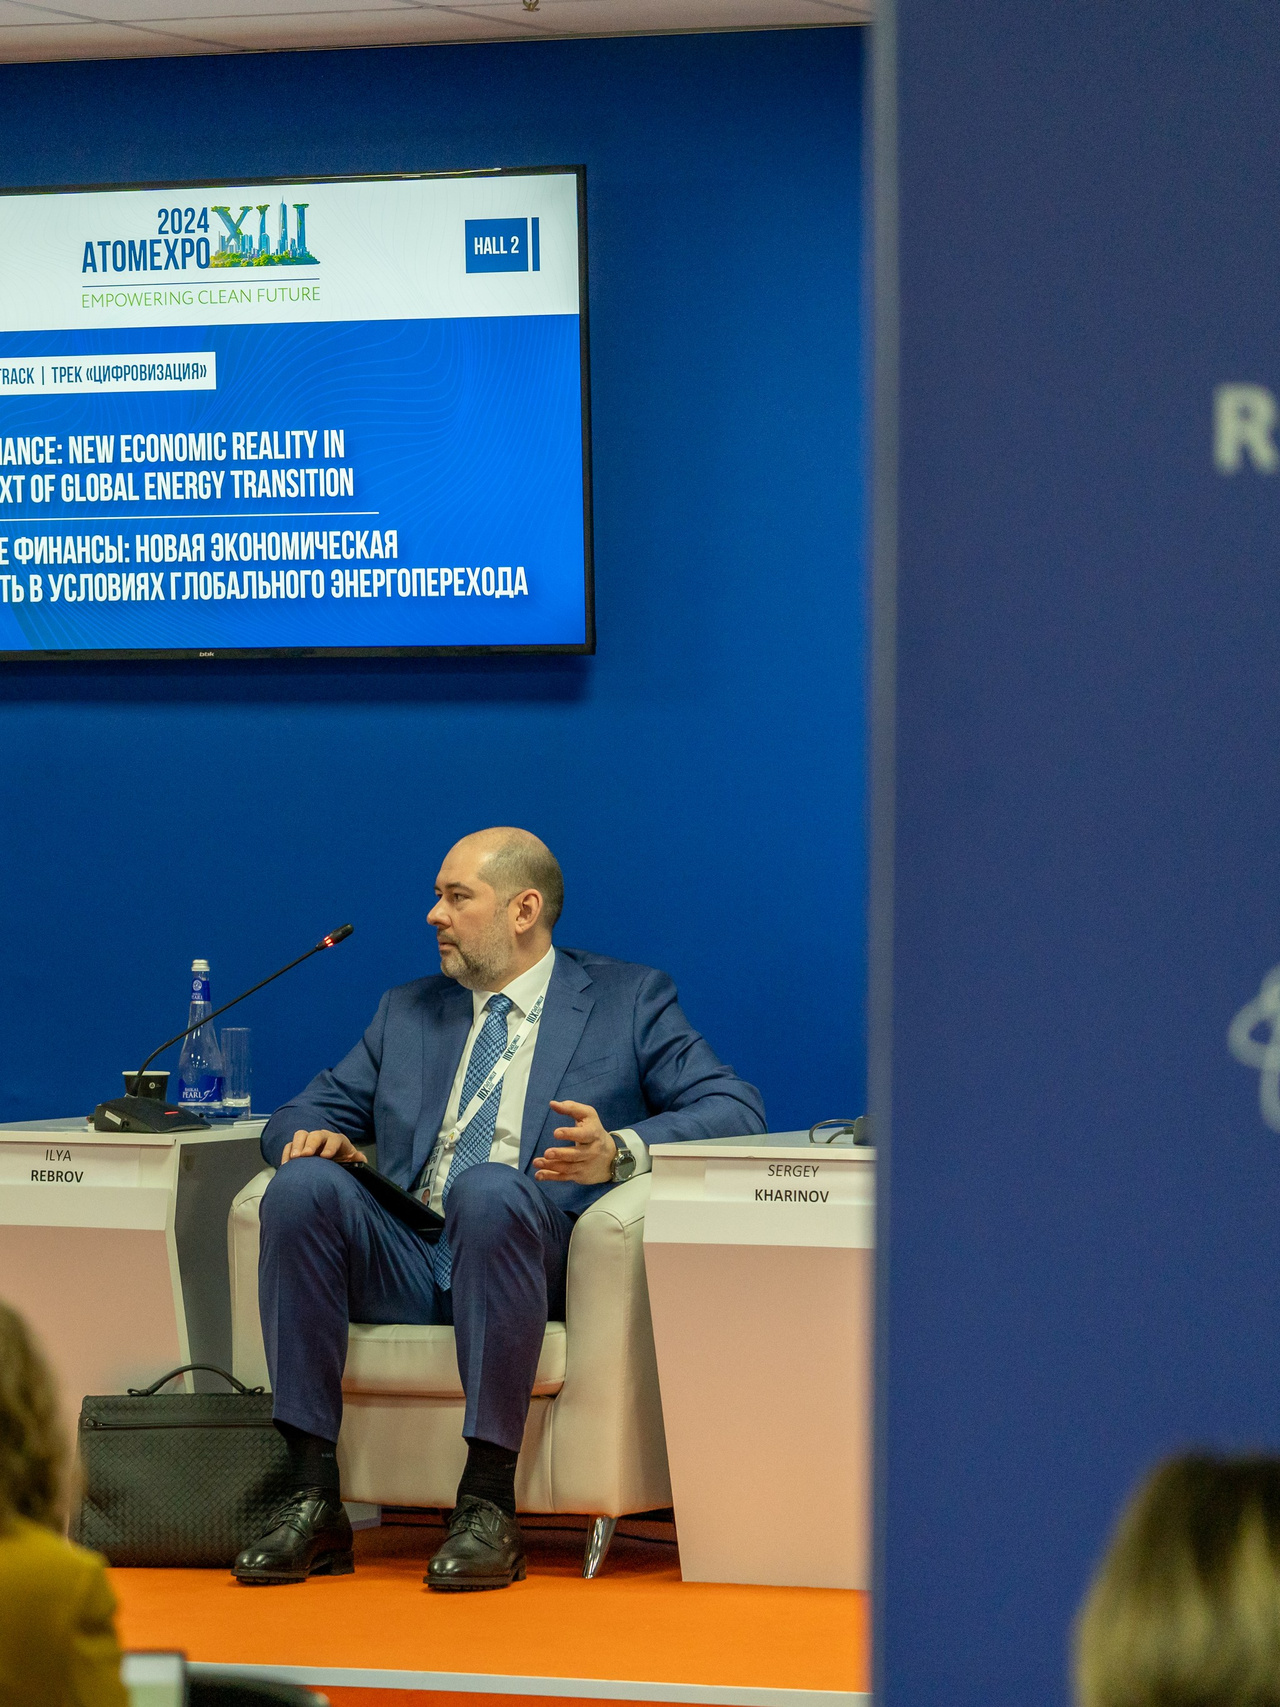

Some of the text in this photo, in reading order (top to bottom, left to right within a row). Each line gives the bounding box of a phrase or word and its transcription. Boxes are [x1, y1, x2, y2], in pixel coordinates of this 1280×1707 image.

[157, 207, 210, 235] 2024
[82, 237, 210, 273] ATOMEXPO
[474, 235, 520, 255] HALL 2
[82, 286, 321, 309] EMPOWERING CLEAN FUTURE
[51, 366, 83, 384] ТРЕК
[86, 362, 207, 384] «ЦИФРОВИЗАЦИЯ»
[69, 434, 115, 464] NEW
[120, 431, 227, 463] ECONOMIC
[232, 429, 318, 460] REALITY
[323, 429, 345, 459] IN
[30, 474, 56, 503] OF
[61, 471, 140, 503] GLOBAL
[144, 469, 225, 500] ENERGY
[230, 467, 354, 499] TRANSITION
[13, 534, 130, 565] ФИНАНСЫ:
[135, 533, 205, 563] НОВАЯ
[210, 529, 398, 562] ЭКОНОМИЧЕСКАЯ
[29, 573, 43, 603] В
[47, 571, 165, 603] УСЛОВИЯХ
[170, 569, 325, 601] ГЛОБАЛЬНОГО
[330, 566, 529, 600] ЭНЕРГОПЕРЕХОДА
[182, 1091, 202, 1099] PEARL
[45, 1149, 72, 1162] ILYA
[30, 1169, 84, 1183] REBROV
[767, 1164, 820, 1178] SERGEY
[754, 1188, 830, 1203] KHARINOV
